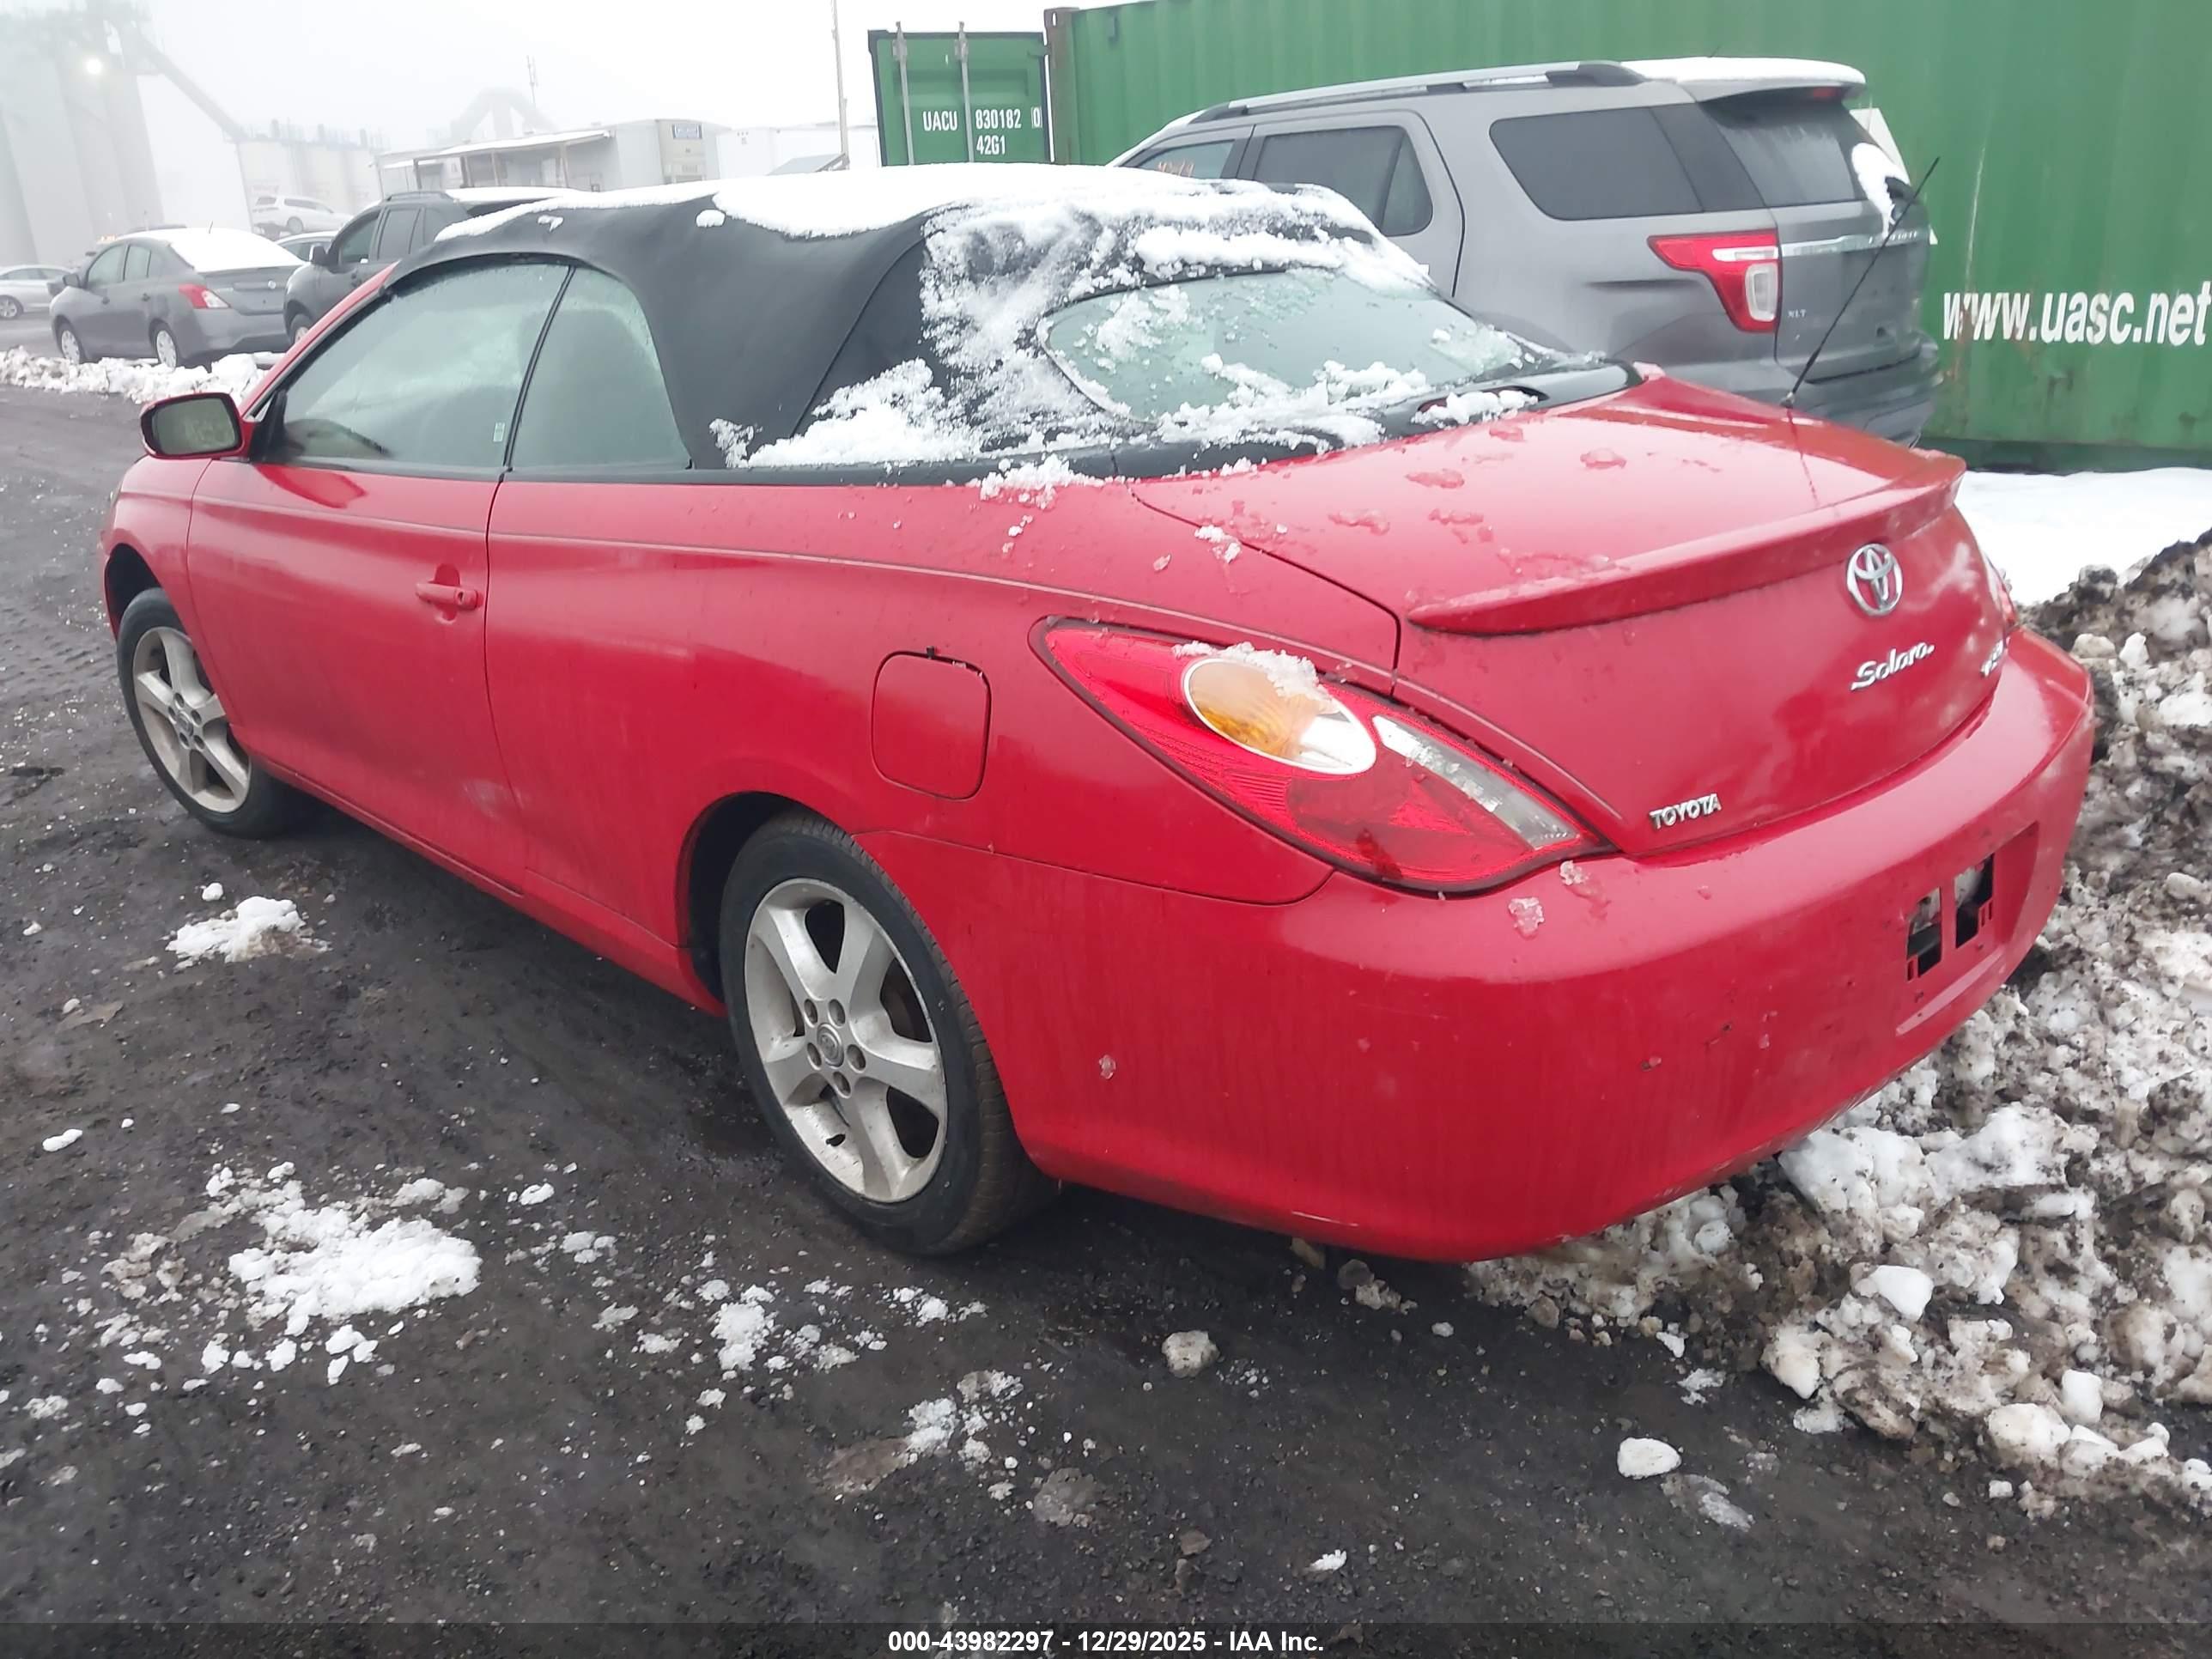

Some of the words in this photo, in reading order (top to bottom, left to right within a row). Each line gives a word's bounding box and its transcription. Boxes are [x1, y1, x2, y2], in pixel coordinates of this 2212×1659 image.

[922, 111, 958, 131] UACU
[975, 108, 1022, 130] 830182
[976, 135, 1006, 155] 42G1
[1943, 280, 2212, 346] www.uasc.net
[1850, 641, 1936, 690] Solara
[1649, 792, 1723, 830] TOYOTA
